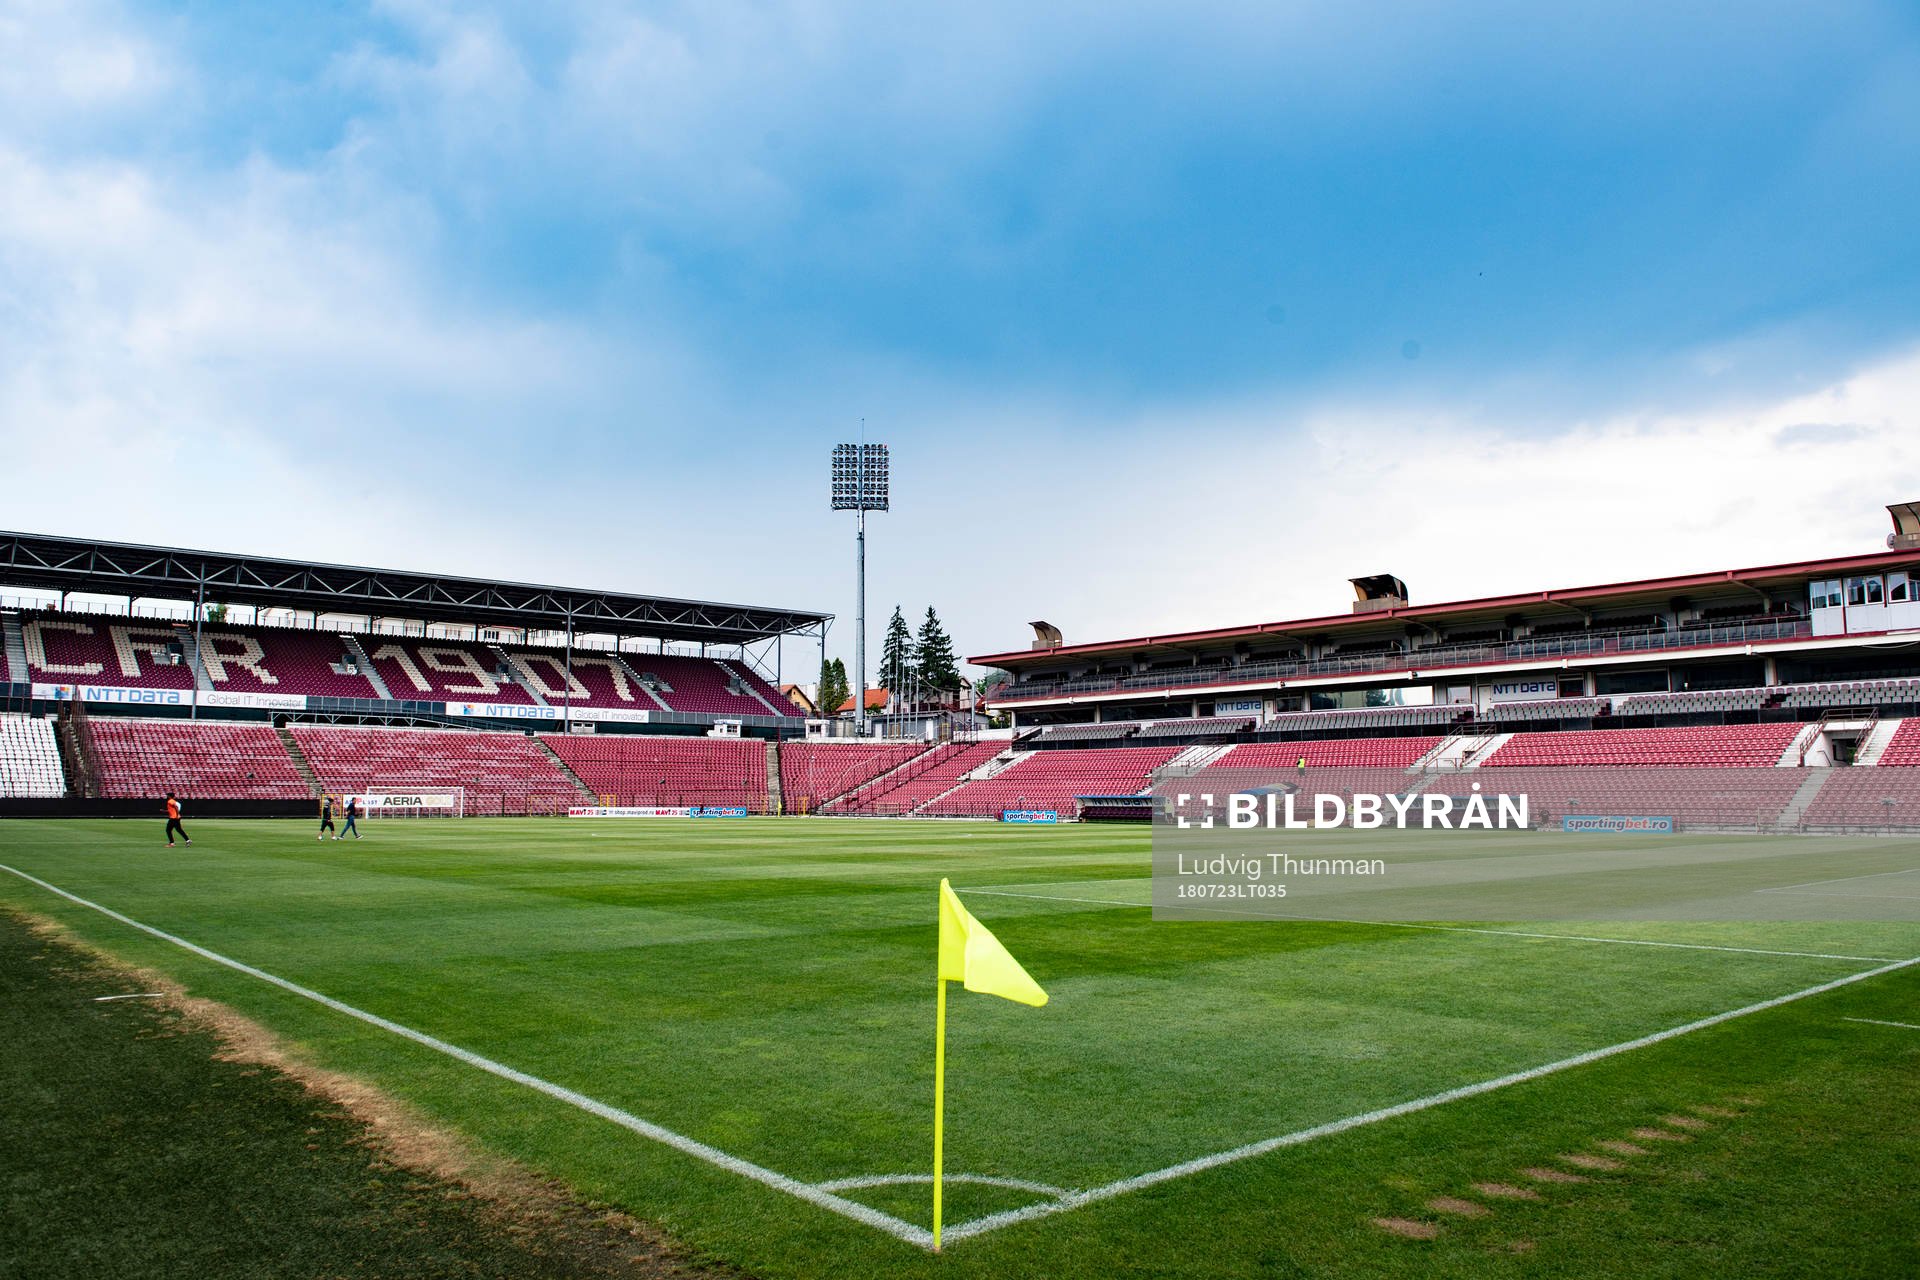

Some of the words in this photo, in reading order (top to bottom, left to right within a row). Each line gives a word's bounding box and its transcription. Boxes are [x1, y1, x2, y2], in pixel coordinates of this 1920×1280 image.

[207, 693, 241, 706] Global
[243, 695, 253, 706] IT
[256, 696, 303, 708] Innovator
[574, 709, 600, 720] Global
[611, 712, 645, 722] Innovator
[383, 796, 422, 806] AERIA
[692, 808, 744, 817] sportingbet.ro
[1006, 811, 1055, 822] sportingbet.ro
[1567, 817, 1668, 831] sportingbet.ro
